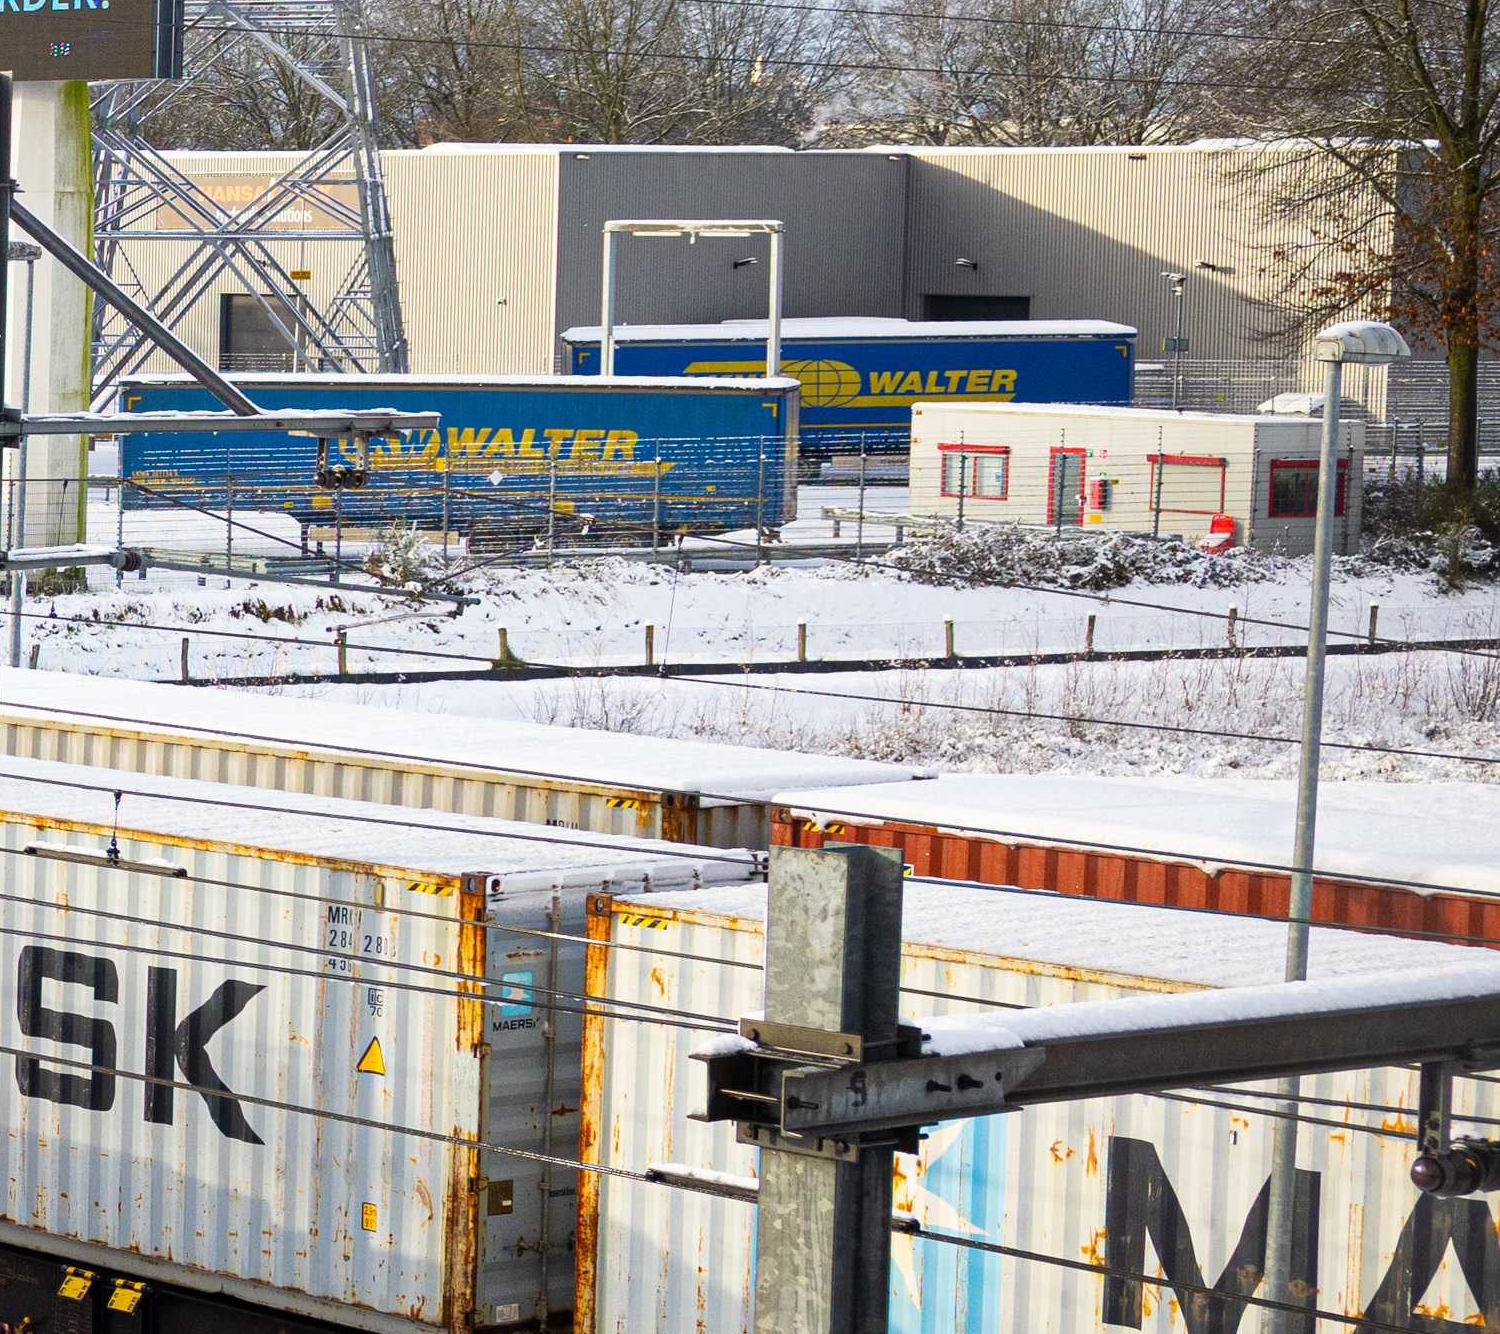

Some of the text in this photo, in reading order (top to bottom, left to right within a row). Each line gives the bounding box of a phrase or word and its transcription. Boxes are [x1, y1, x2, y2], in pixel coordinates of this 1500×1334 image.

[869, 369, 1017, 394] WALTER
[446, 428, 638, 461] WALTER
[370, 1006, 383, 1017] 70
